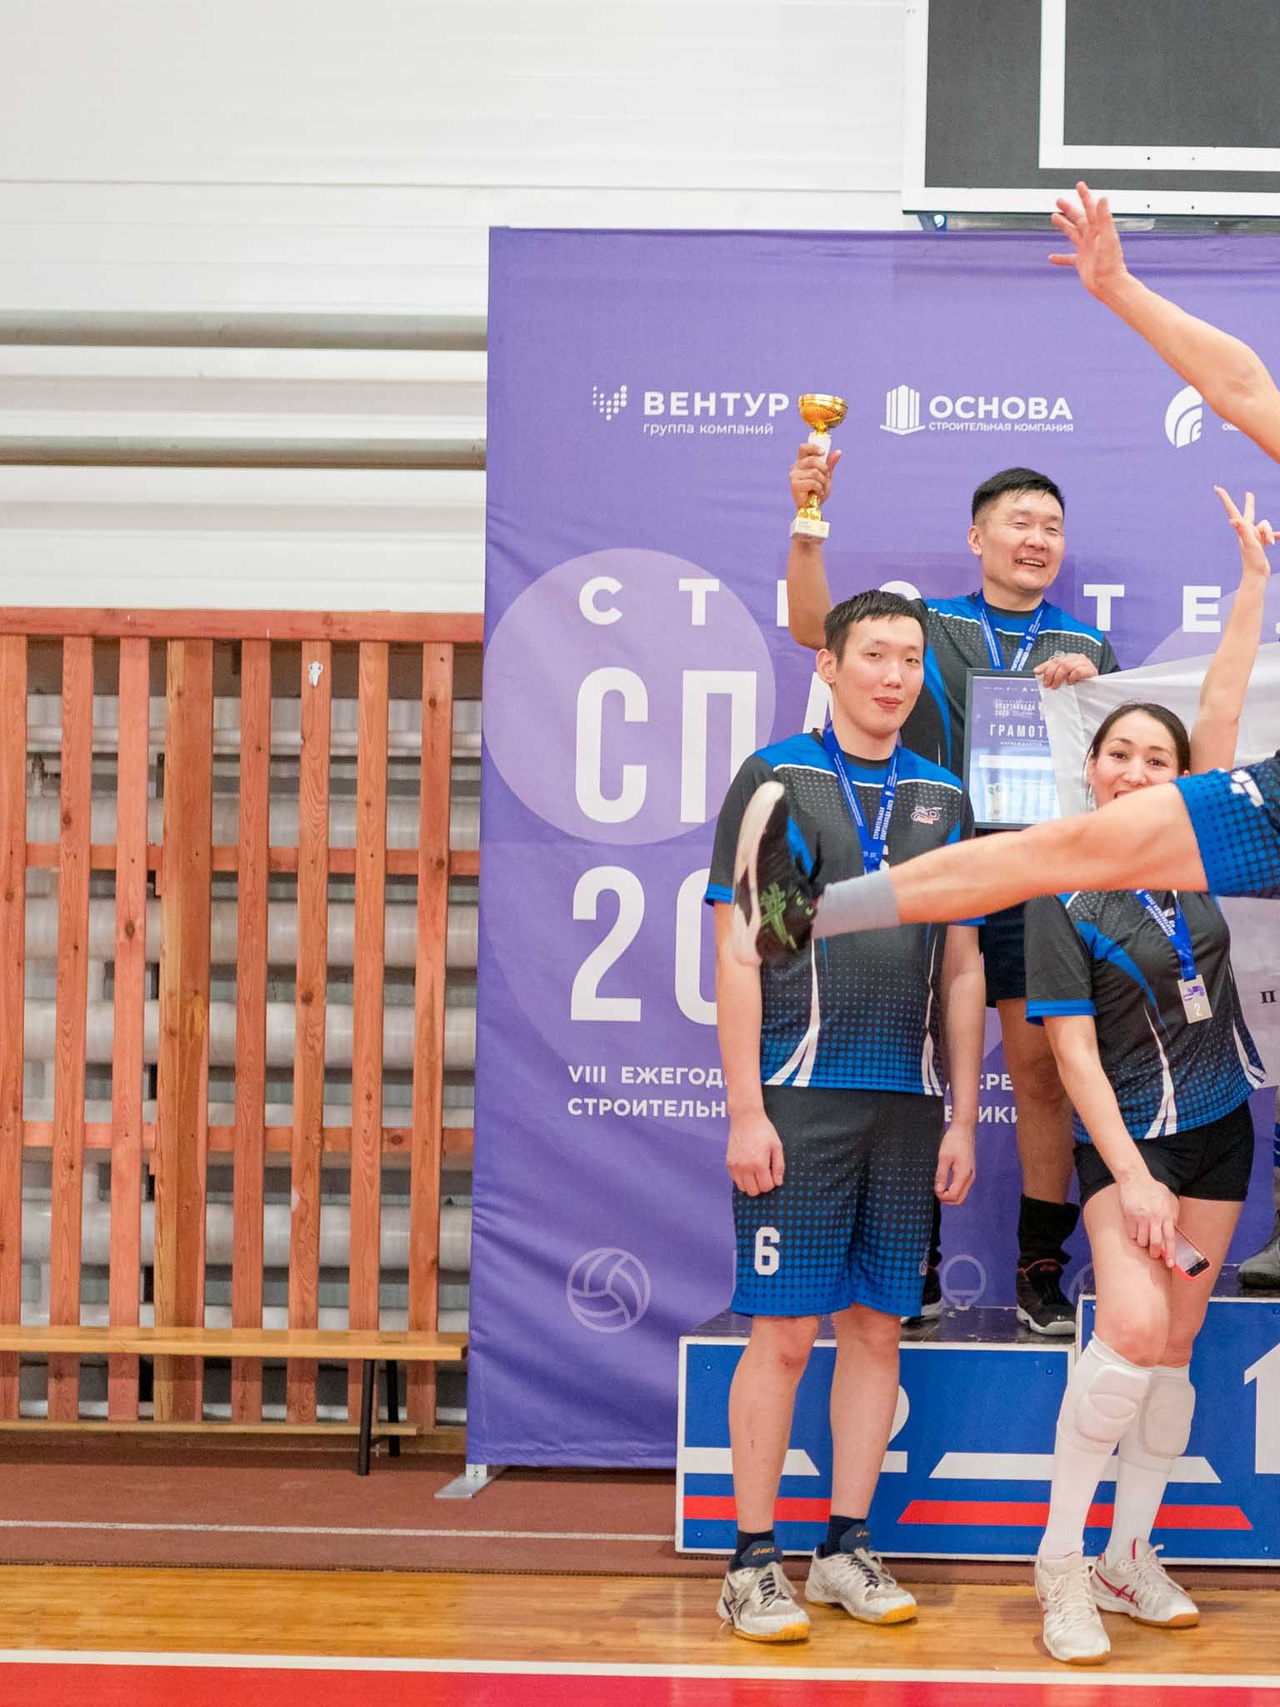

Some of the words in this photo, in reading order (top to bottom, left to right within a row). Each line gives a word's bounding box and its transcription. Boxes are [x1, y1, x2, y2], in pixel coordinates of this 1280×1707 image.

[642, 391, 790, 418] ВЕНТУР
[929, 396, 1073, 421] ОСНОВА
[642, 423, 695, 437] группа
[699, 422, 774, 436] компаний
[928, 421, 1012, 433] СТРОИТЕЛЬНАЯ
[1014, 423, 1074, 434] КОМПАНИЯ
[989, 723, 1049, 738] ГРАМОТ
[1193, 1002, 1202, 1017] 2
[567, 1066, 606, 1085] VIII
[620, 1066, 727, 1089] ЕЖЕГОД
[567, 1097, 727, 1120] СТРОИТЕЛЬН
[754, 1226, 781, 1276] 6
